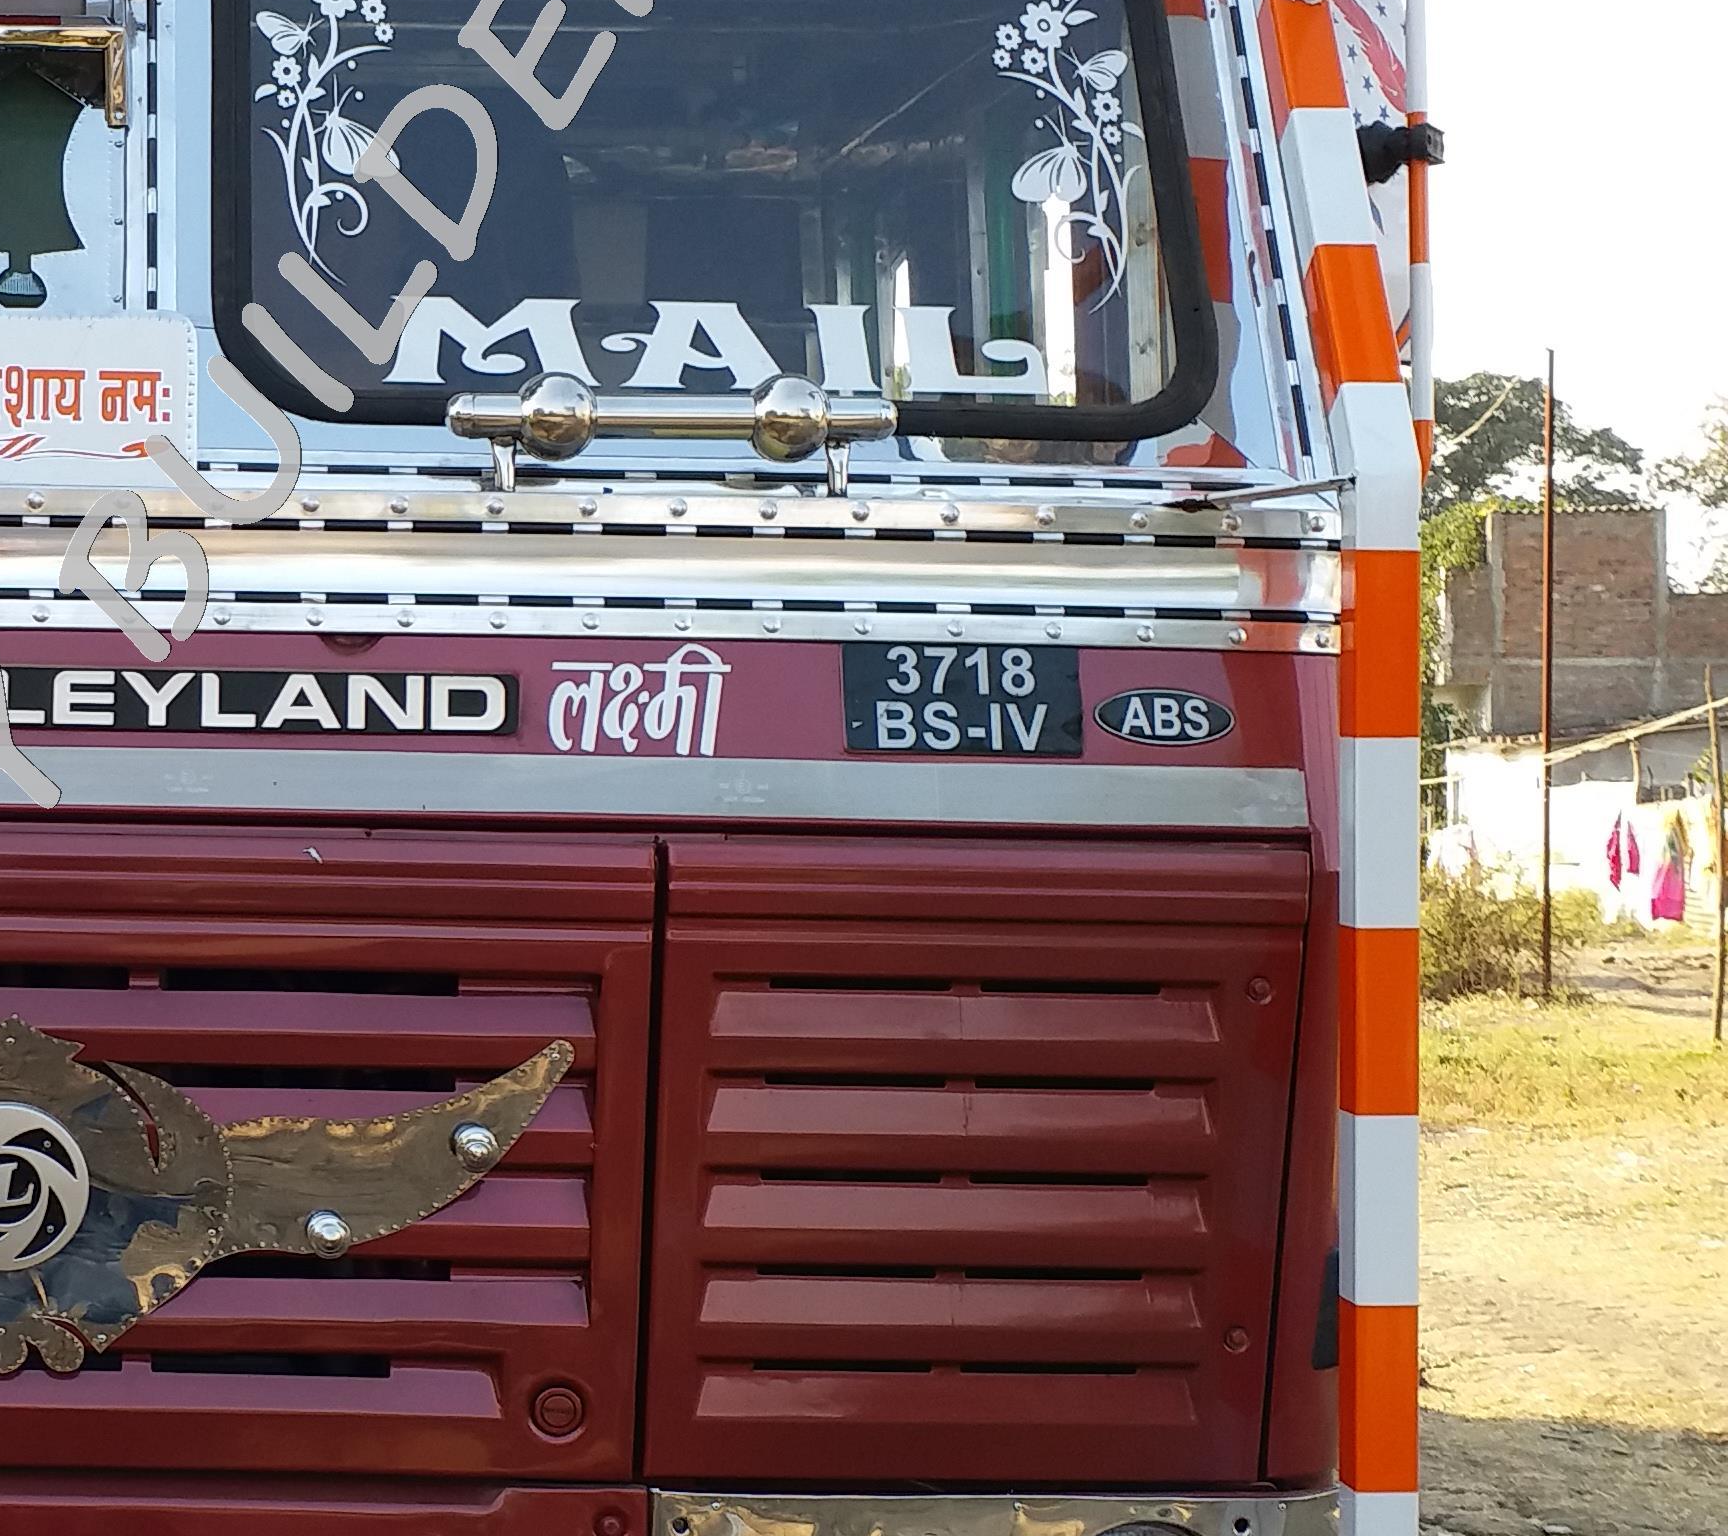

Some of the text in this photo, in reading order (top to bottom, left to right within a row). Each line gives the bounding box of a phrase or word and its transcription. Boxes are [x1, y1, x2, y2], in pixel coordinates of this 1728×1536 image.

[383, 295, 1047, 395] MAIL
[886, 646, 1036, 697] 3718
[549, 643, 731, 757] लक्ष्मी
[876, 700, 1048, 751] BS-IV
[1121, 696, 1210, 738] ABS
